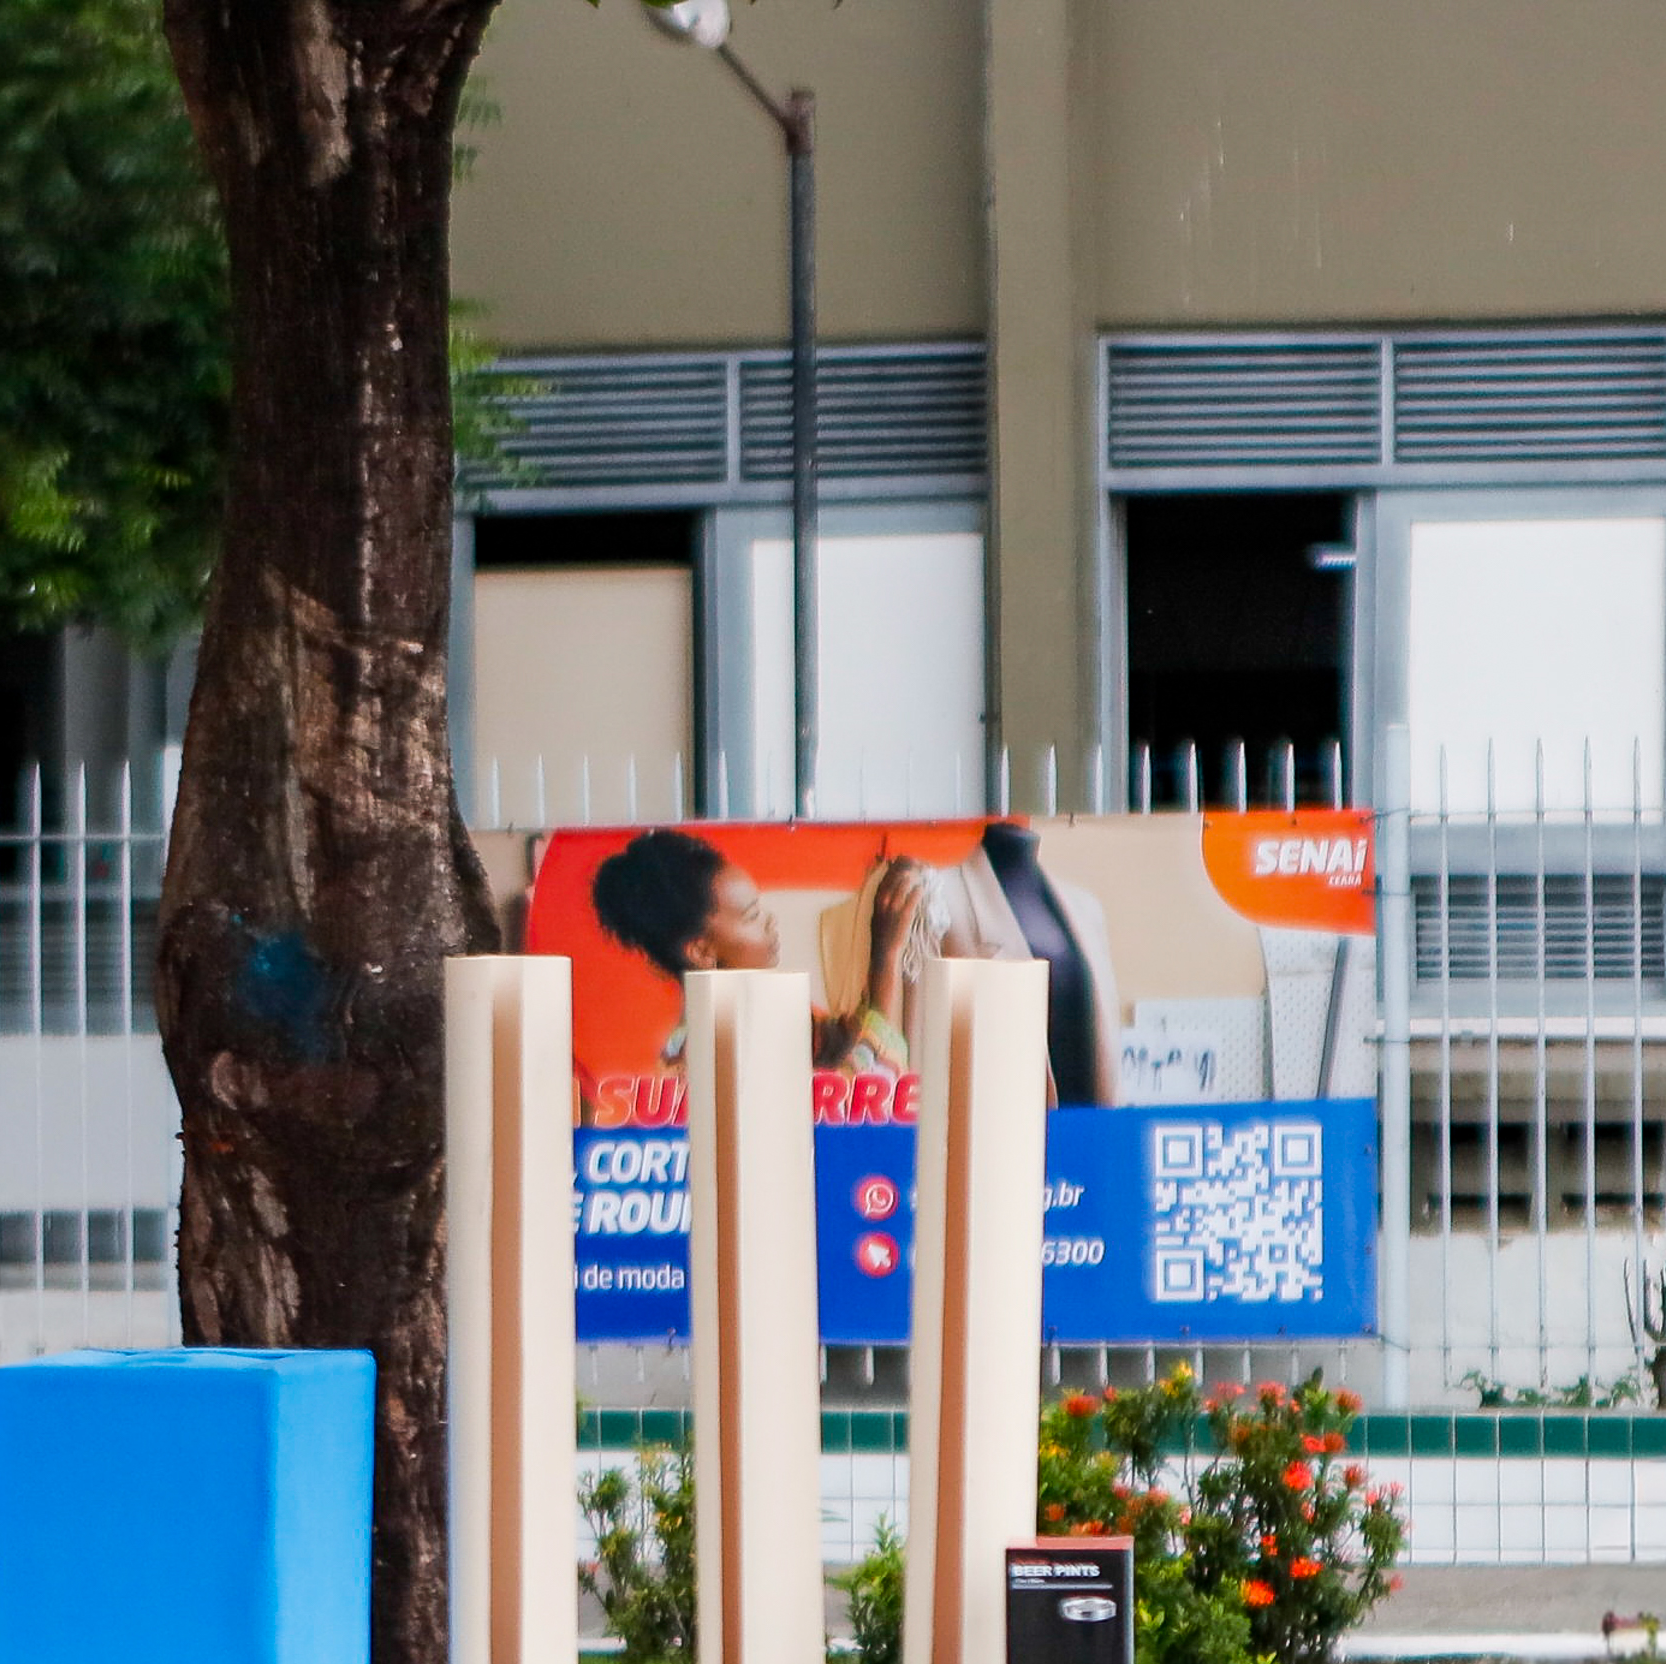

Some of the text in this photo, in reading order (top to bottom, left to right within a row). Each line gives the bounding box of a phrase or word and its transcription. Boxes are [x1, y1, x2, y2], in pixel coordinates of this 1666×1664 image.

[813, 1072, 920, 1126] RRE
[589, 1142, 689, 1183] CORT
[588, 1191, 691, 1234] ROU
[1042, 1240, 1104, 1266] 6300
[585, 1263, 613, 1289] de
[618, 1263, 685, 1290] moda
[1013, 1564, 1101, 1578] BEER PINTS
